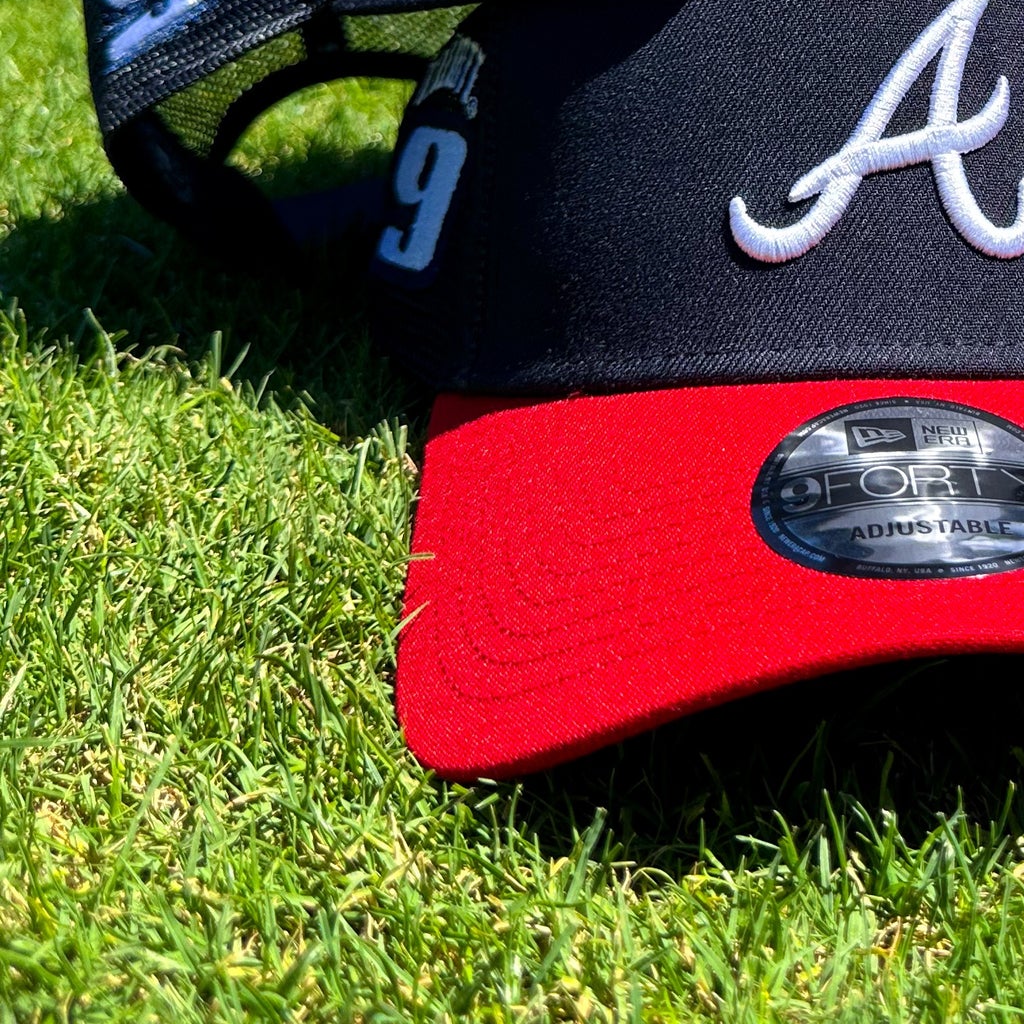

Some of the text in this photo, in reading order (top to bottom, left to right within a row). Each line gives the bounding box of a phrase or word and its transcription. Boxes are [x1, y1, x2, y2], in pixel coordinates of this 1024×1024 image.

[378, 125, 469, 272] 9
[922, 424, 968, 436] NEW
[924, 435, 971, 447] ERA
[850, 519, 1013, 542] ADJUSTABLE
[977, 562, 999, 571] 1920
